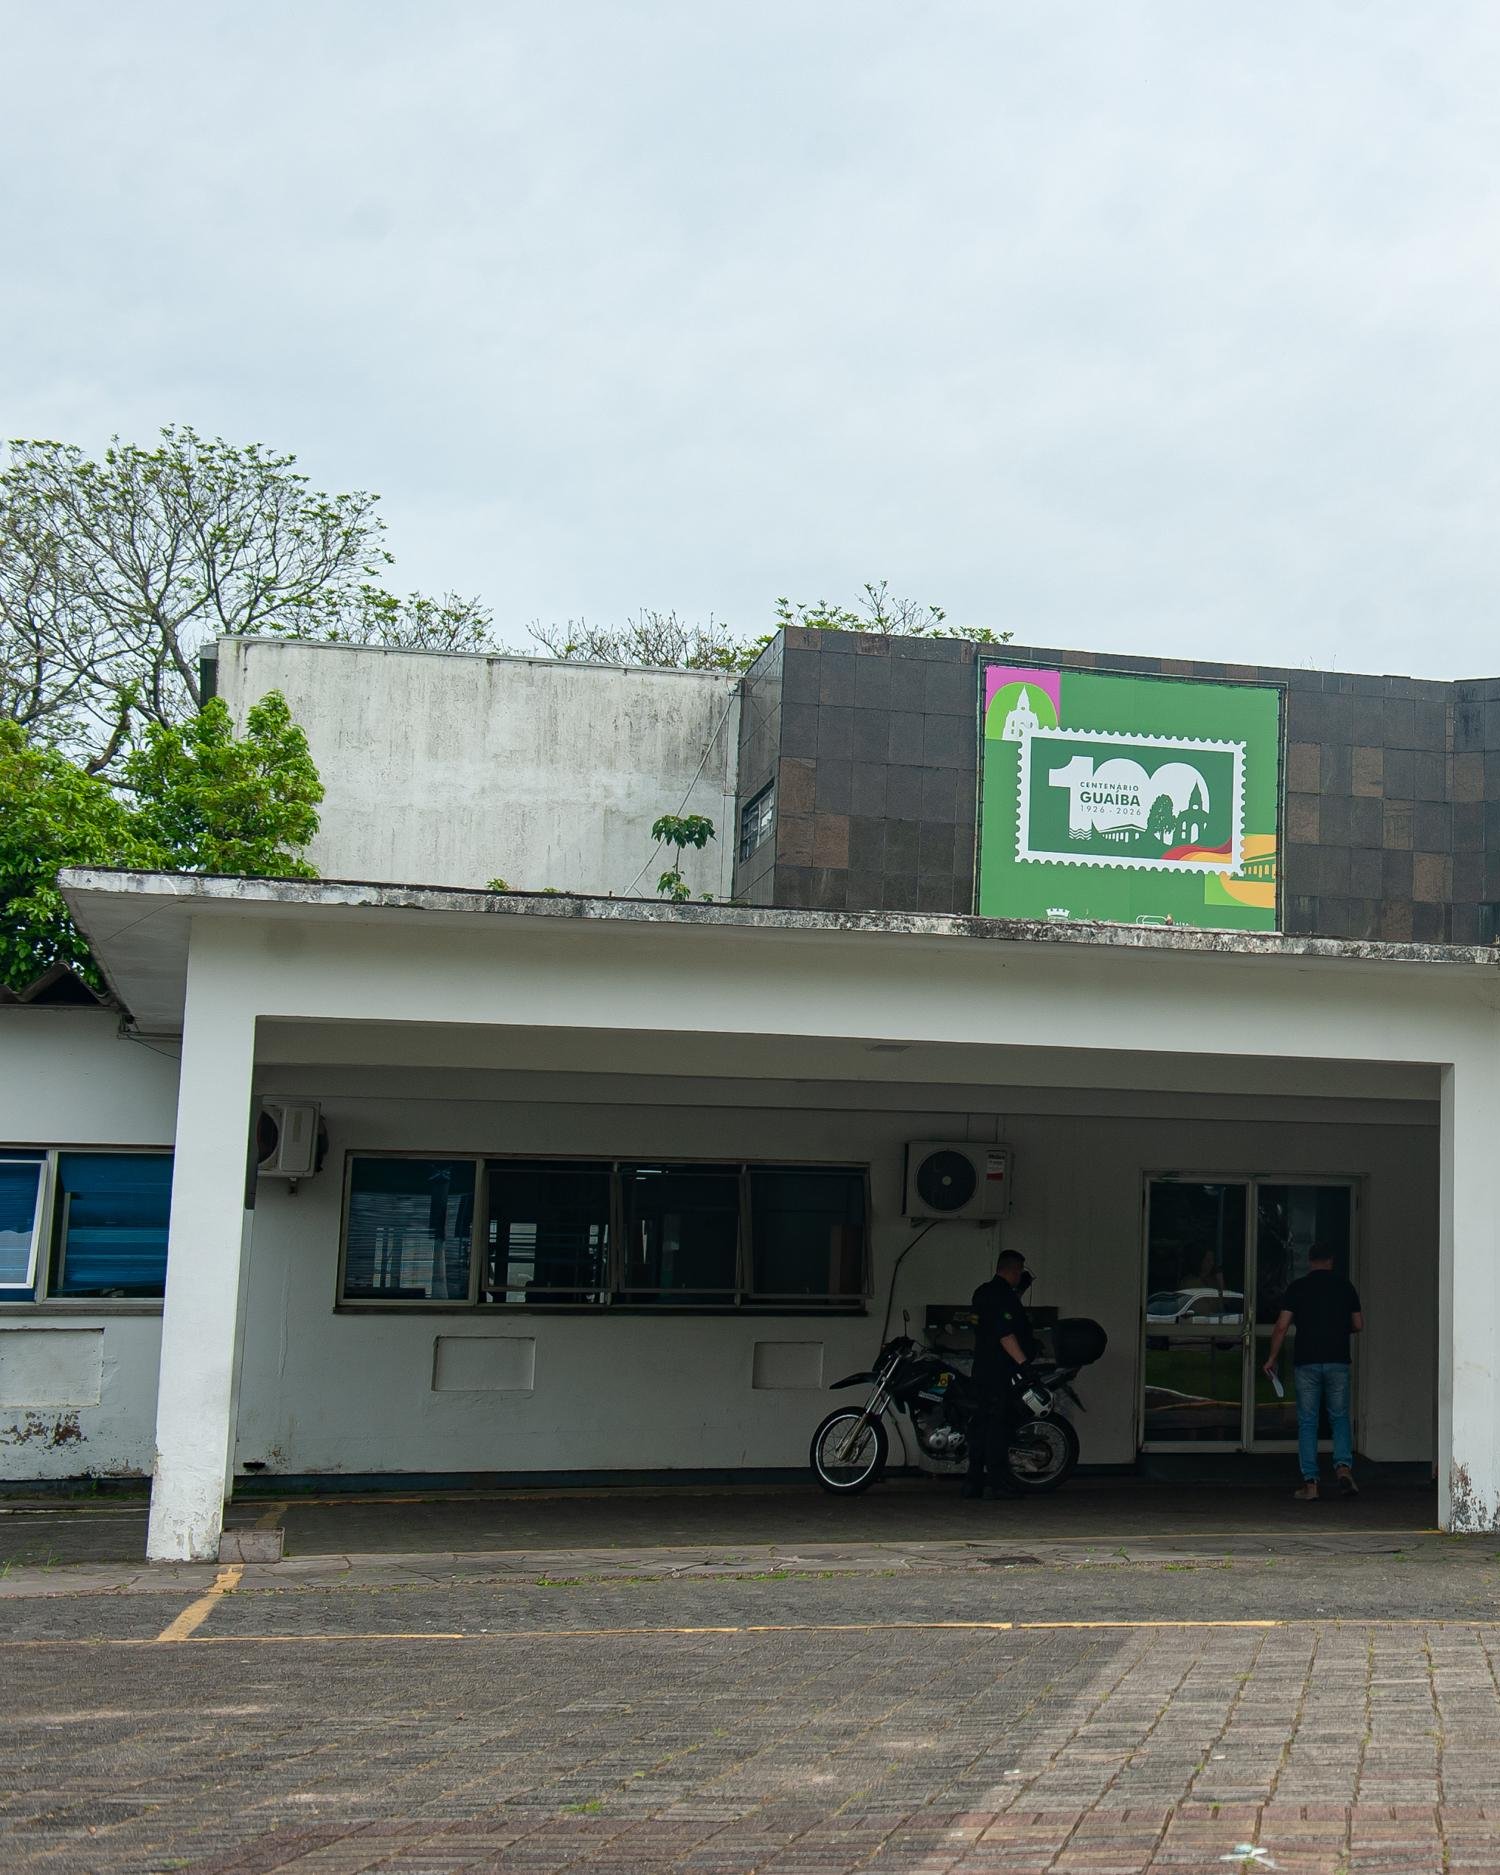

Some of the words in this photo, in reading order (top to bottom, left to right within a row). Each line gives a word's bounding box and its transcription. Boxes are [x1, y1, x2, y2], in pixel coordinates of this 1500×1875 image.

[1079, 781, 1139, 792] CENTENÁRIO
[1049, 755, 1210, 842] 100
[1080, 790, 1141, 807] GUAÍBA
[1081, 805, 1105, 813] 1926
[1116, 807, 1141, 816] 2026
